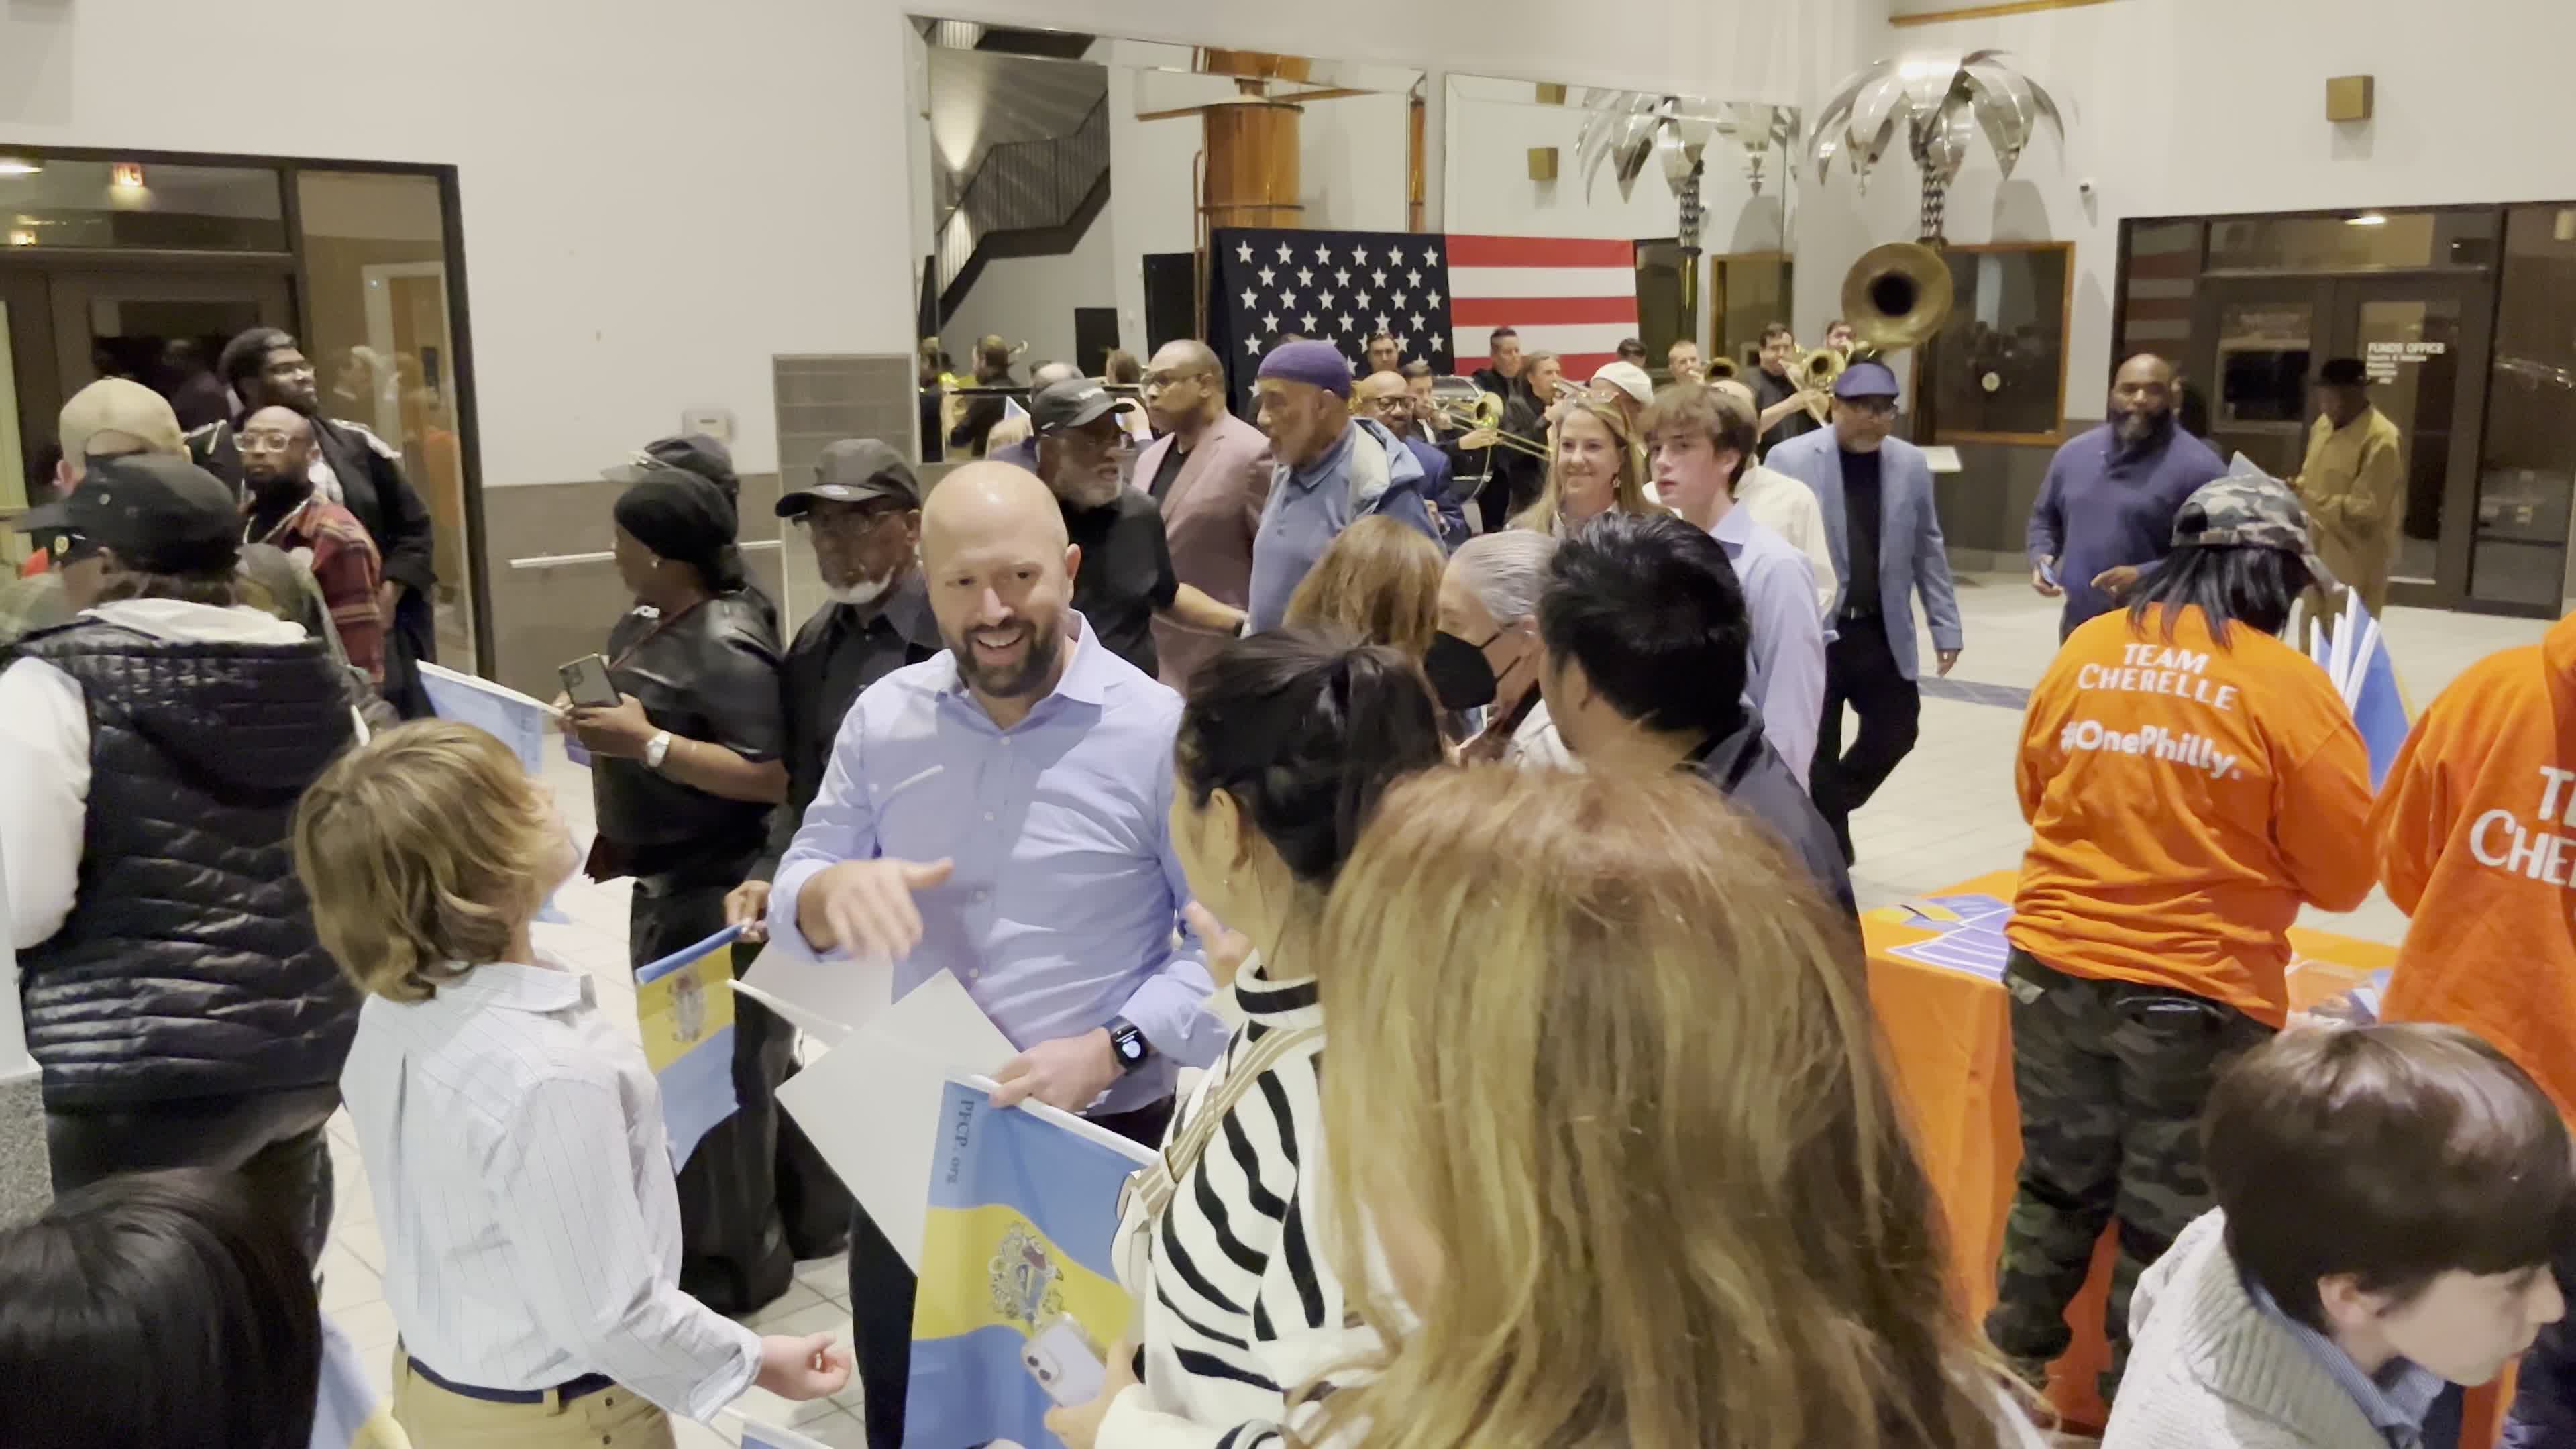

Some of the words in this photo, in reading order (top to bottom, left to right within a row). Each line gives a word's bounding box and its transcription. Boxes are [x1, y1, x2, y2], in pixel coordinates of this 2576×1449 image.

[2406, 343, 2445, 354] OFFICE
[2123, 643, 2210, 674] TEAM
[2078, 663, 2238, 710] CHERELLE
[2470, 809, 2576, 888] CHE
